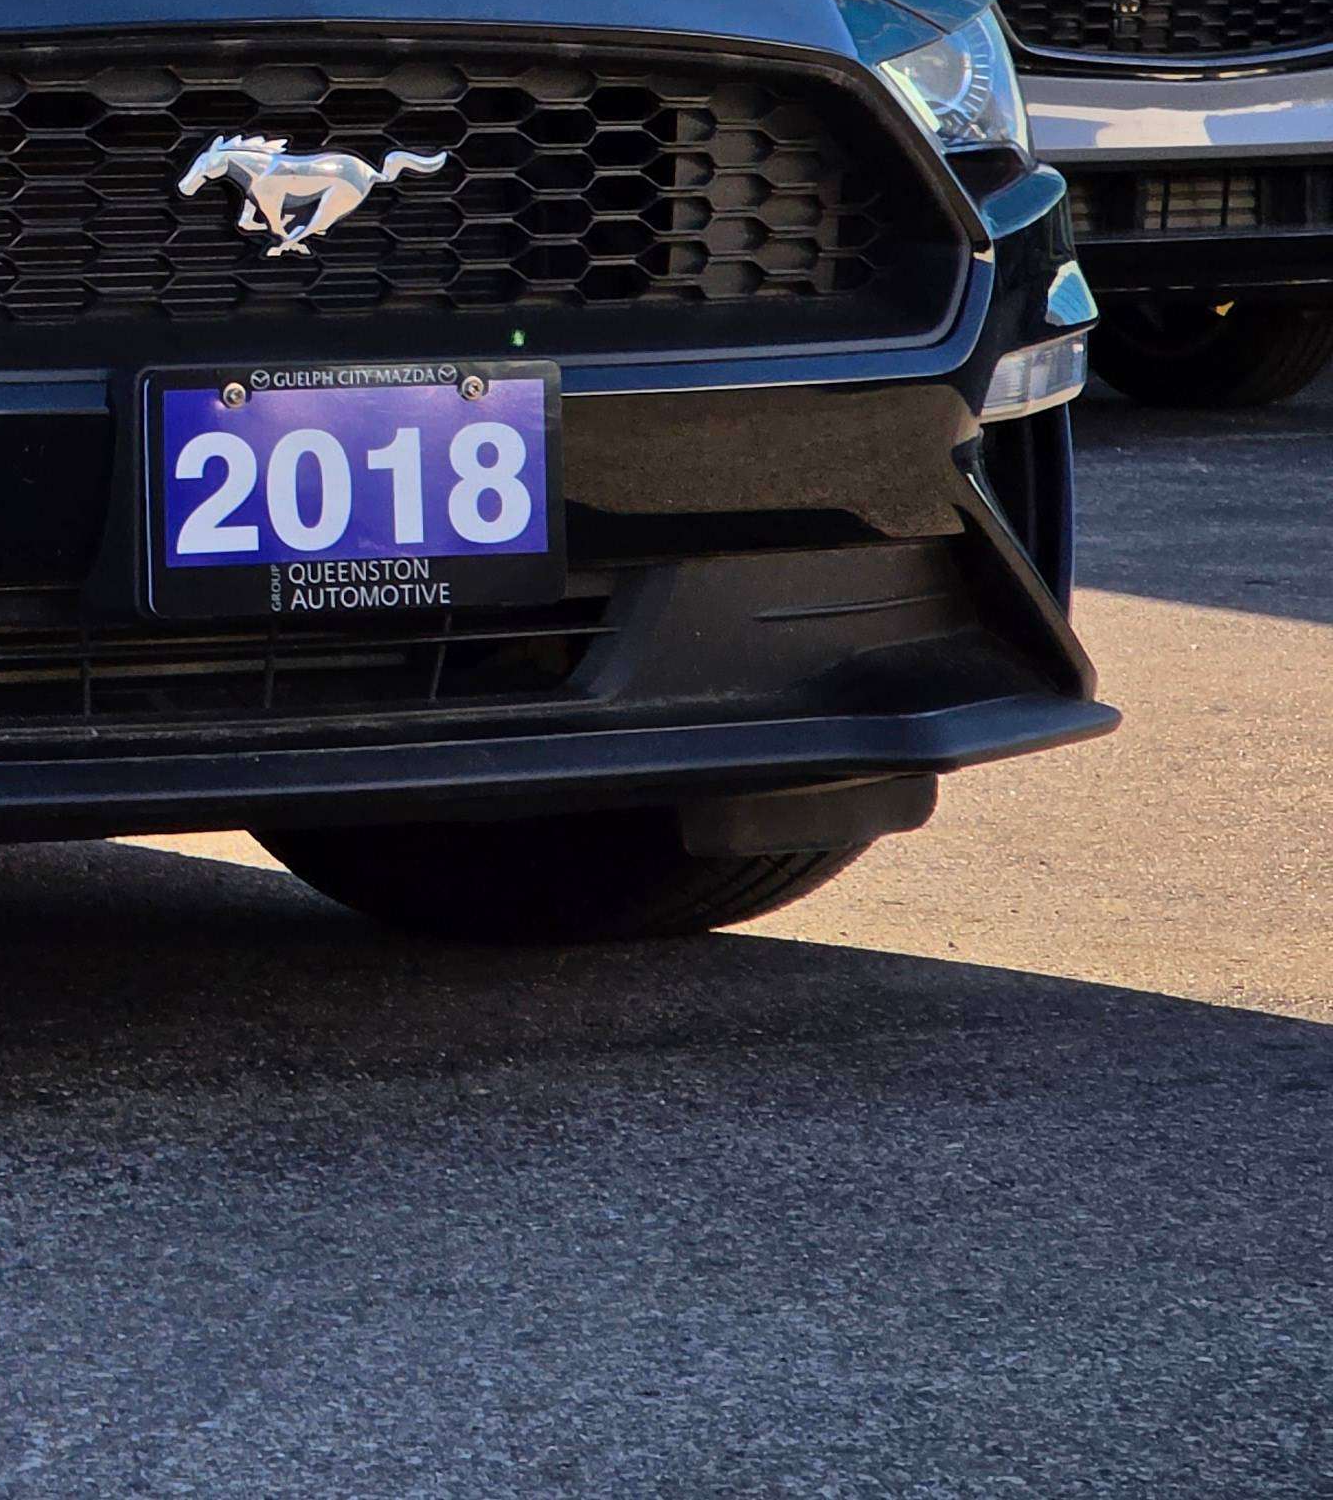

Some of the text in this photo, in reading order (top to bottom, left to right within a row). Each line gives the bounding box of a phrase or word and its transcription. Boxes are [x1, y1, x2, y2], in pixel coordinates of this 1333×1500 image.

[273, 366, 436, 387] GUELPH CITY MAZDA
[175, 422, 532, 555] 2018
[288, 558, 430, 586] QUEENSTON
[270, 564, 282, 611] GROUP
[290, 583, 451, 610] AUTOMOTIVE
